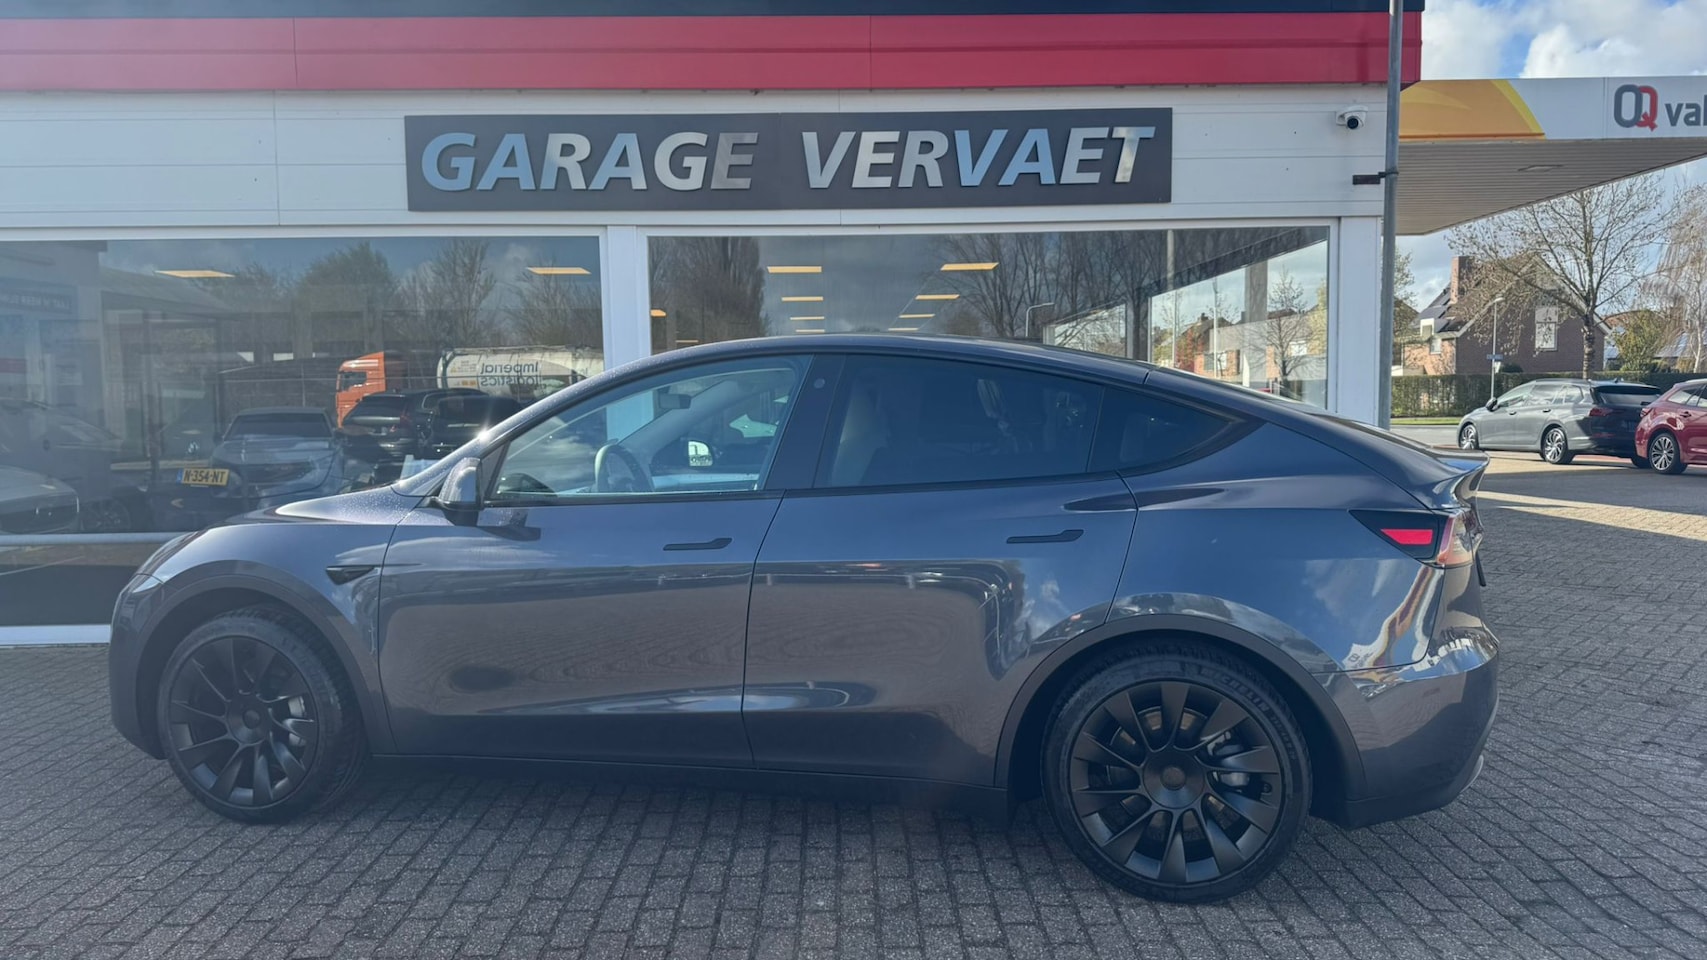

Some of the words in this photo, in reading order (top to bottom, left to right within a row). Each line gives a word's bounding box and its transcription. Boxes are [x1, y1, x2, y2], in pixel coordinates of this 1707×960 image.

[1614, 84, 1658, 132] OQ
[421, 131, 759, 192] GARAGE
[802, 126, 1156, 189] VERVAET
[183, 469, 227, 484] N-354-NT
